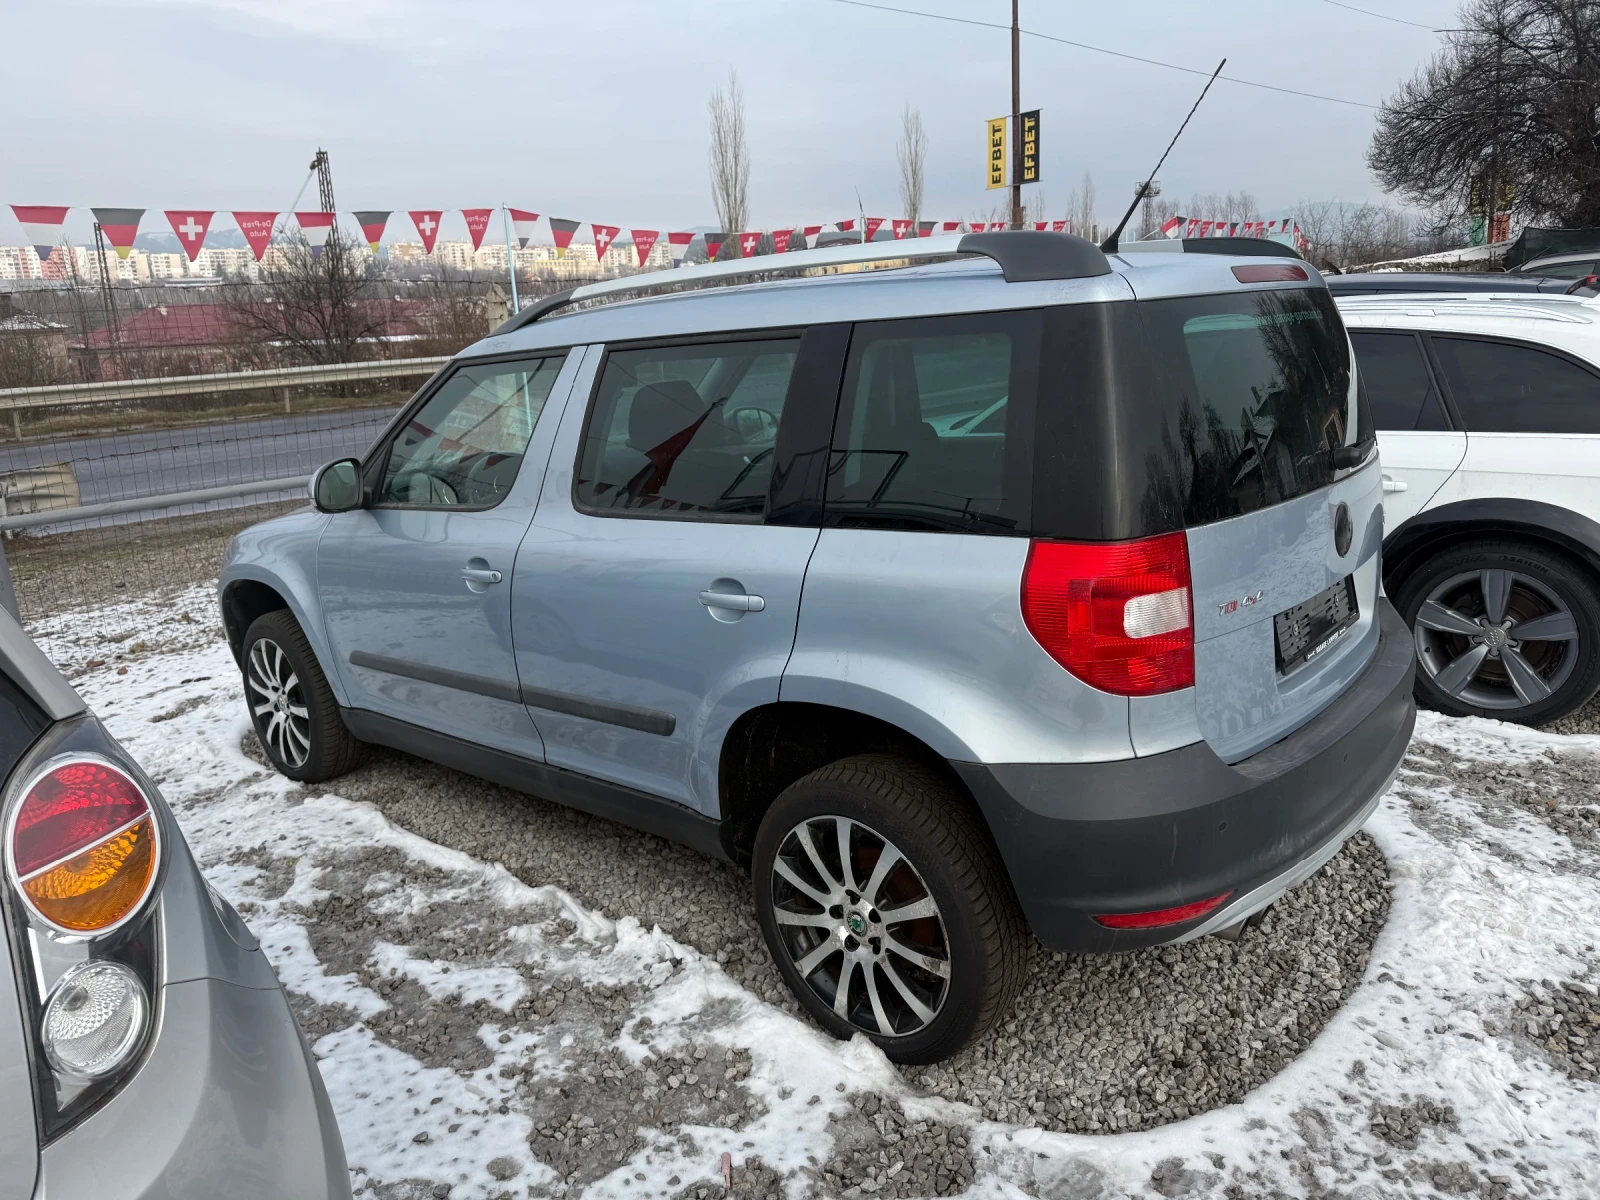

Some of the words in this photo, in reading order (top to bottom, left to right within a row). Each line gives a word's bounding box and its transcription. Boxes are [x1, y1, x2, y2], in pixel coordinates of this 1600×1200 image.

[991, 124, 1002, 184] EFBET
[1024, 117, 1035, 180] EFBET
[1509, 557, 1549, 573] SAILUN
